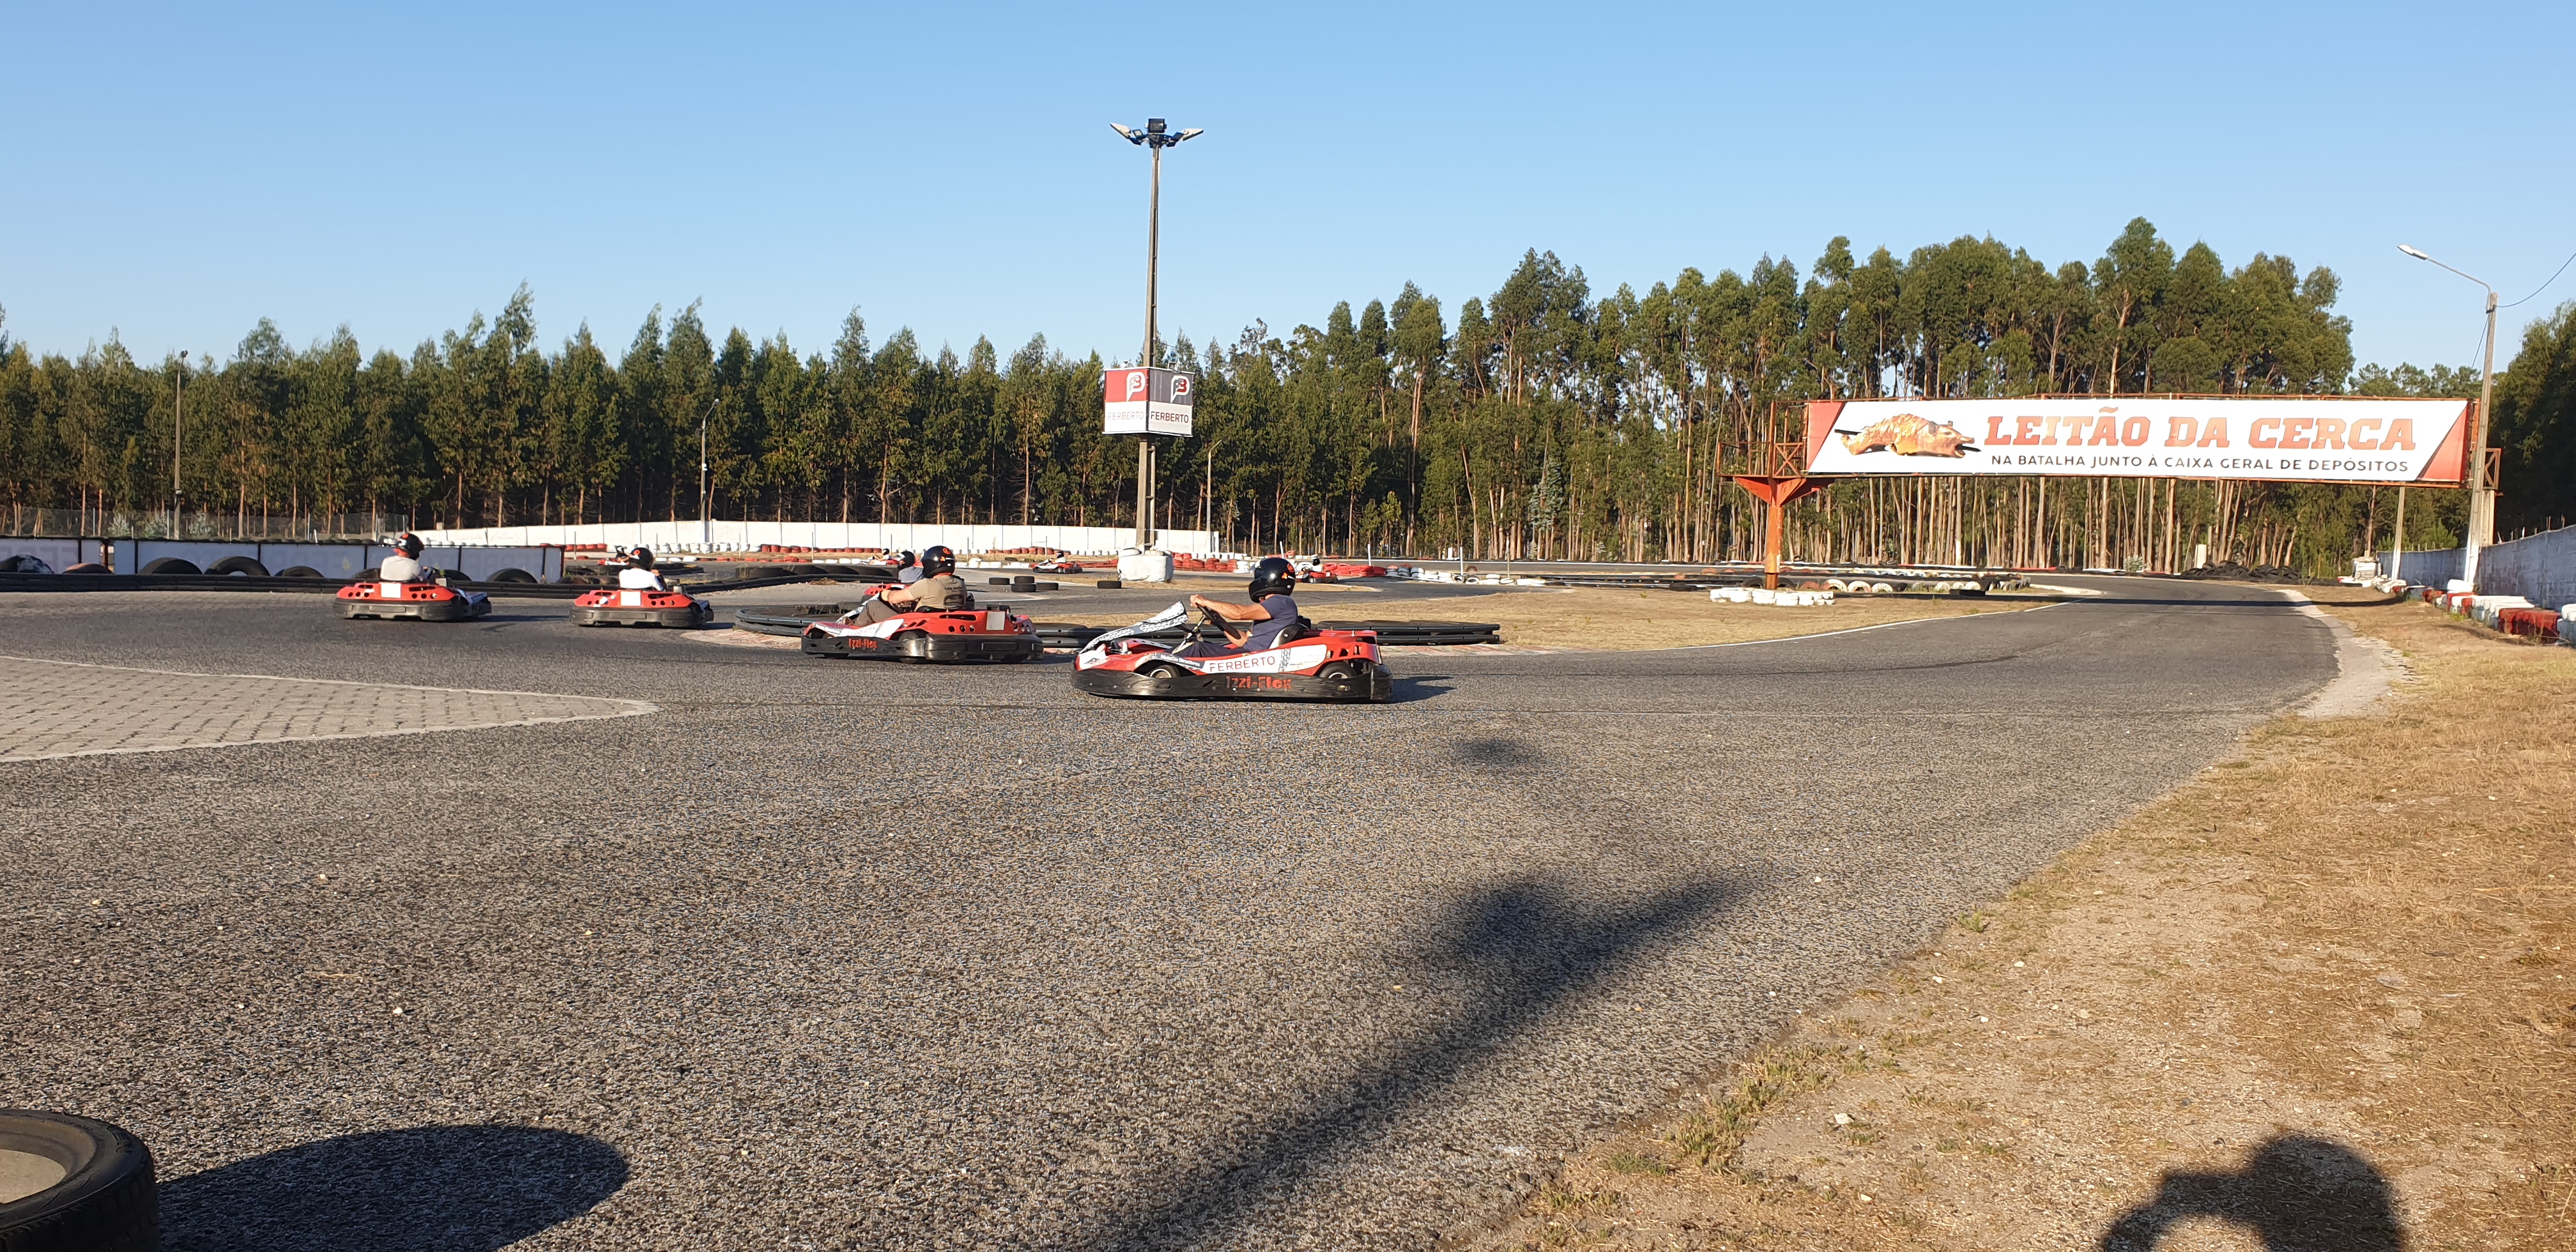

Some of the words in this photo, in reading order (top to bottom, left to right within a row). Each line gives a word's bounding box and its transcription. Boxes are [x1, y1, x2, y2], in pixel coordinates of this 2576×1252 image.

[1107, 411, 1144, 421] FERBERTO
[1151, 411, 1189, 424] FERBERTO
[1984, 406, 2151, 447] LEITÃO
[2164, 416, 2230, 448] DA
[2248, 418, 2416, 451] CERCA
[1991, 455, 2012, 465] NA
[2018, 455, 2085, 466] BATALHA
[2090, 456, 2142, 468] JUNTO
[2165, 457, 2213, 468] CAIXA
[2220, 458, 2273, 470] GERAL
[2280, 459, 2302, 470] DE
[2308, 457, 2408, 471] DEPÓSITOS
[1209, 656, 1275, 673] FERBERTO
